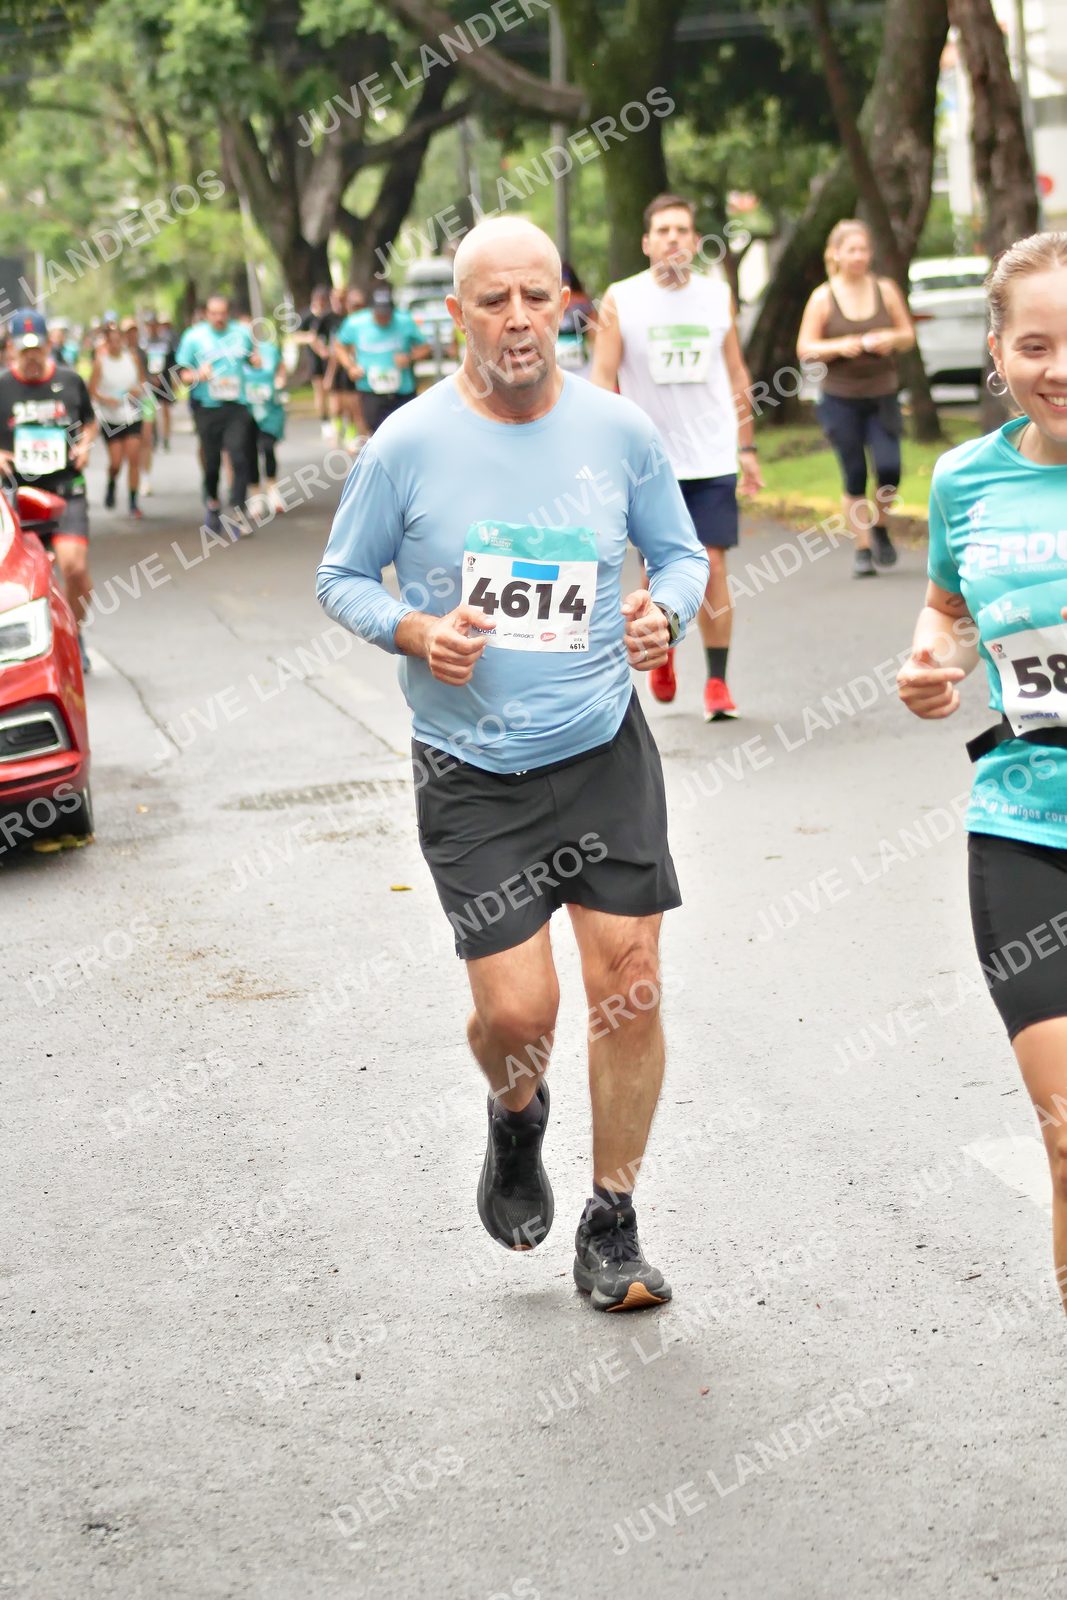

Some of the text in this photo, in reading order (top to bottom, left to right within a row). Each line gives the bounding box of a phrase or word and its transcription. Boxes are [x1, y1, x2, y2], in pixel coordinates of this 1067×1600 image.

[661, 350, 701, 367] 717
[468, 577, 587, 622] 4614
[1002, 803, 1041, 820] amigos
